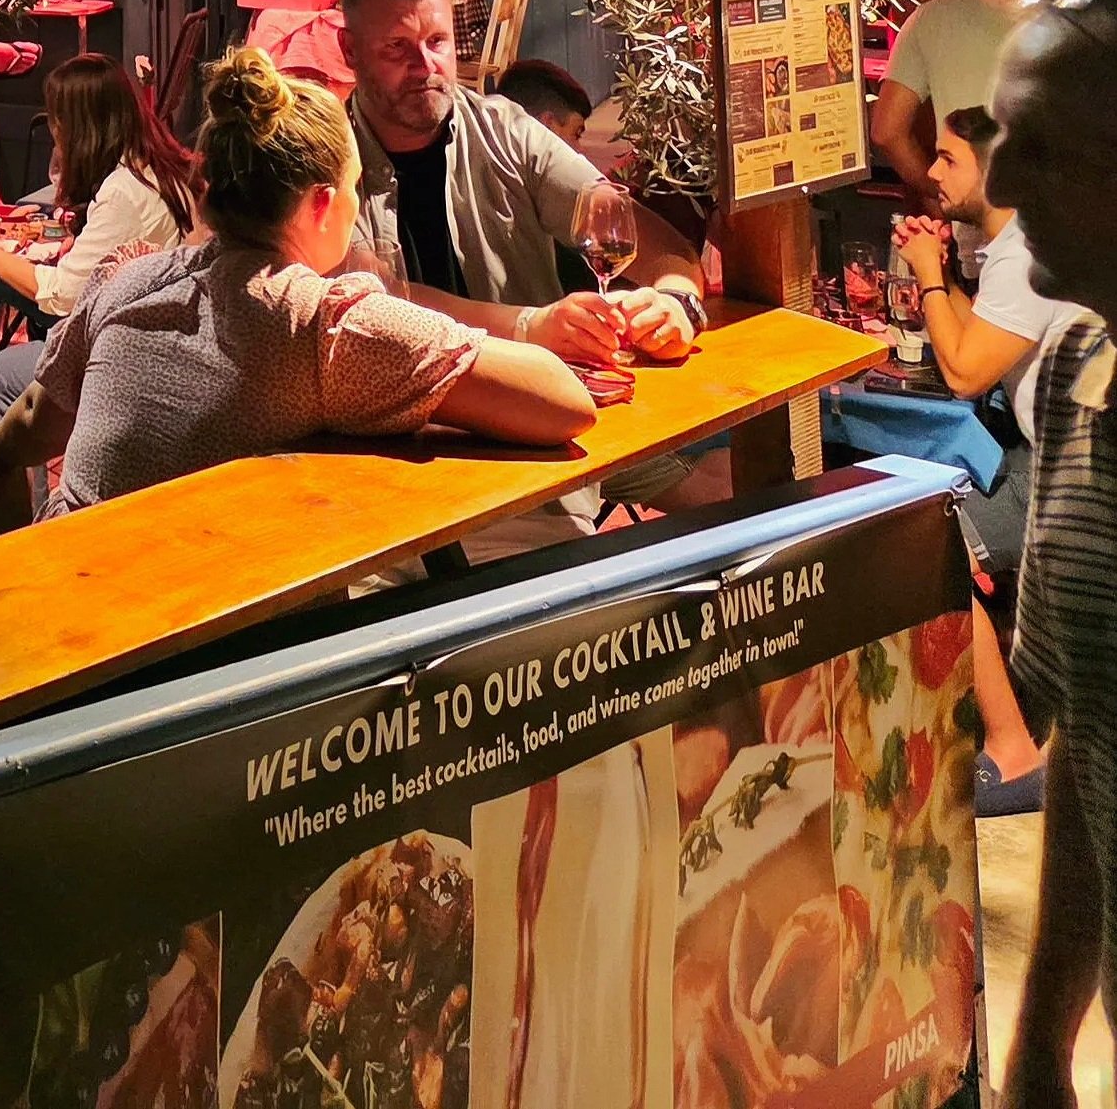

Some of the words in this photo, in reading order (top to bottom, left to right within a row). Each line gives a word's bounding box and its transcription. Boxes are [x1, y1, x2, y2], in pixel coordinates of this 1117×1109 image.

[247, 700, 421, 802] WELCOME
[434, 683, 473, 735] TO
[484, 659, 543, 716] OUR
[553, 611, 691, 689] COCKTAIL
[700, 602, 716, 641] &
[719, 576, 775, 630] WINE
[783, 561, 826, 607] BAR
[264, 800, 347, 847] "Where
[353, 783, 386, 819] the
[392, 766, 432, 804] best
[435, 733, 521, 785] cocktails,
[523, 711, 564, 754] food,
[567, 695, 597, 734] and
[599, 688, 641, 720] wine
[644, 675, 685, 705] come
[687, 647, 743, 690] together
[746, 640, 760, 663] in
[763, 618, 804, 658] town!"
[884, 1013, 941, 1080] PINSA
